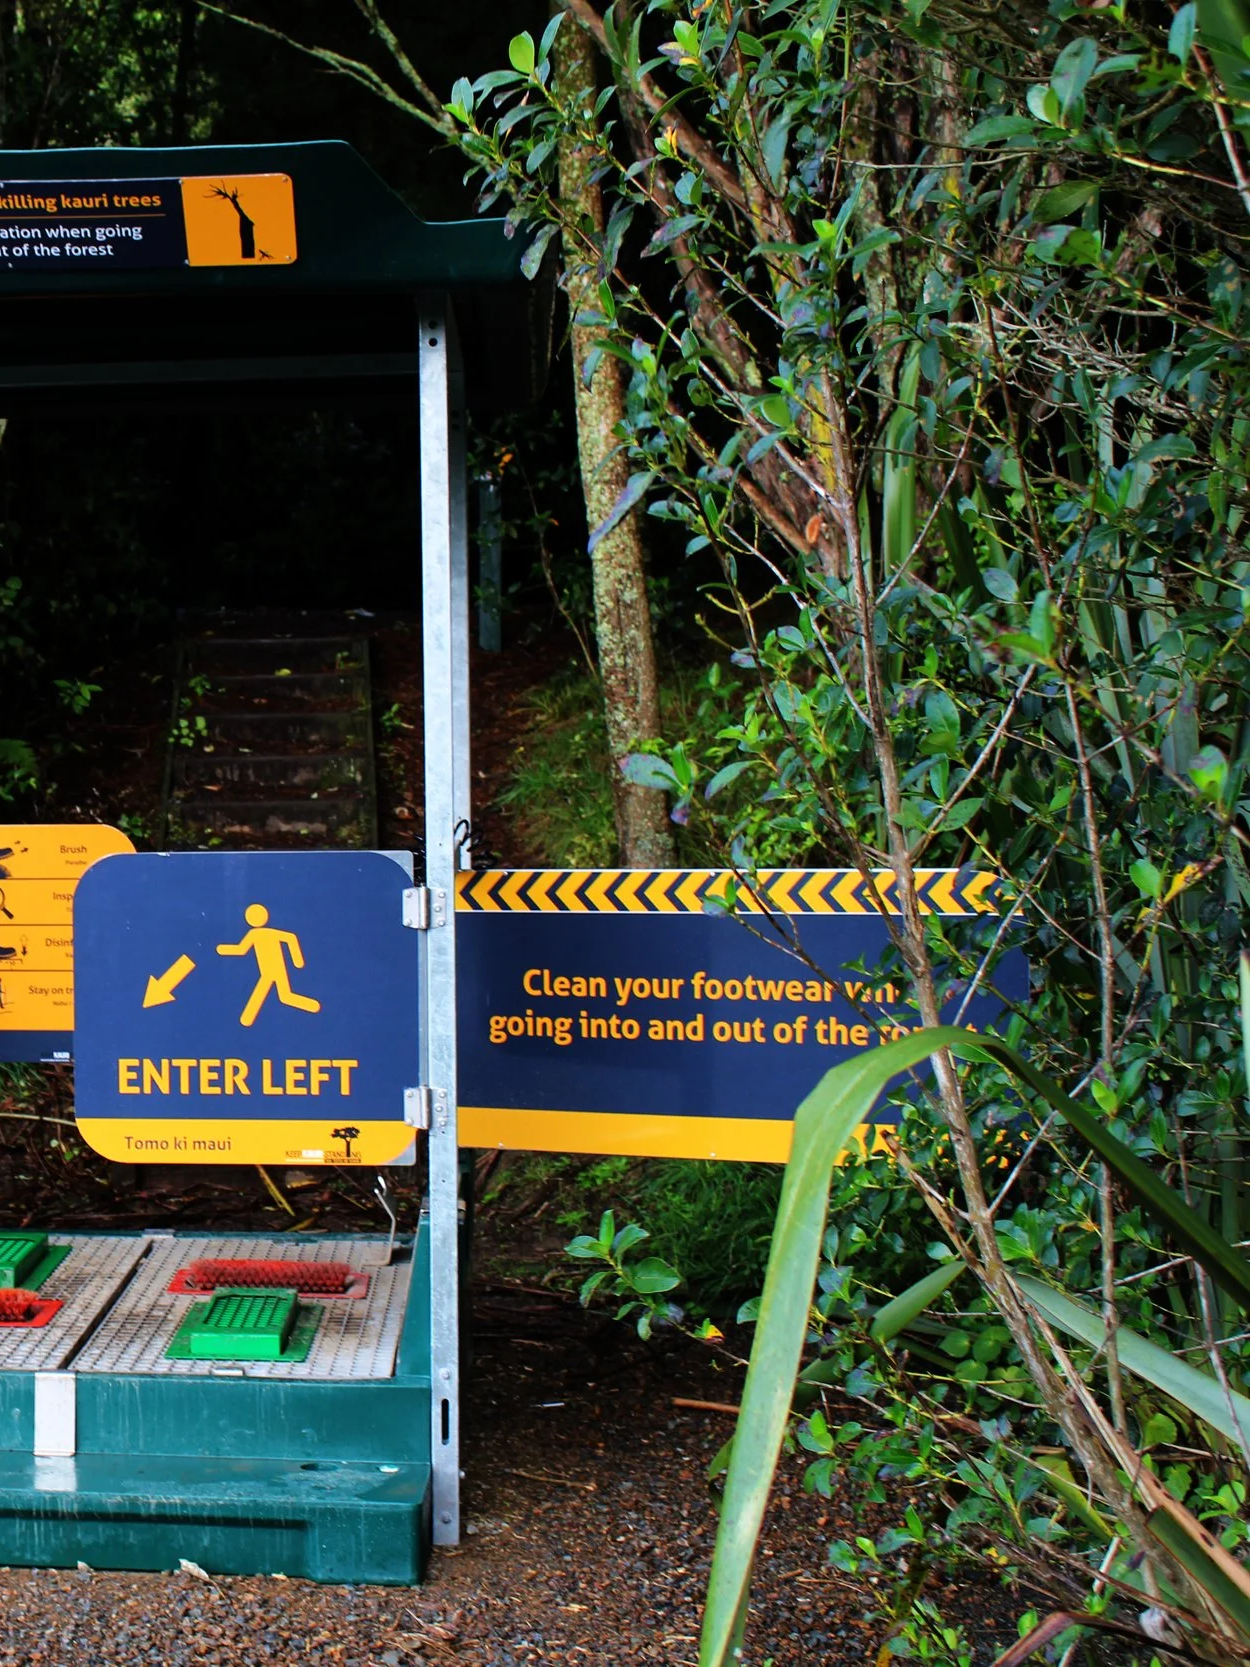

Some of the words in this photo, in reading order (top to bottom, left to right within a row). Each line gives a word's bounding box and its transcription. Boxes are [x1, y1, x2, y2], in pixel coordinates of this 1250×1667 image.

[61, 193, 108, 208] kauri
[113, 194, 161, 207] trees
[45, 224, 91, 239] when
[95, 224, 143, 241] going
[12, 243, 30, 257] of
[34, 243, 61, 257] the
[65, 242, 114, 257] forest
[60, 844, 87, 854] Brush
[53, 891, 74, 902] Insp
[28, 985, 49, 996] Stay
[51, 987, 64, 995] on
[523, 968, 607, 998] Clean
[614, 976, 685, 1006] your
[691, 971, 835, 1003] footwear
[489, 1009, 573, 1046] going
[579, 1010, 641, 1040] into
[647, 1013, 705, 1042] and
[712, 1017, 766, 1044] out
[773, 1016, 808, 1044] of
[814, 1016, 869, 1046] the
[118, 1058, 251, 1095] ENTER
[262, 1059, 358, 1095] LEFT
[124, 1136, 169, 1150] Tomo
[173, 1136, 187, 1150] ki
[193, 1136, 232, 1150] maui
